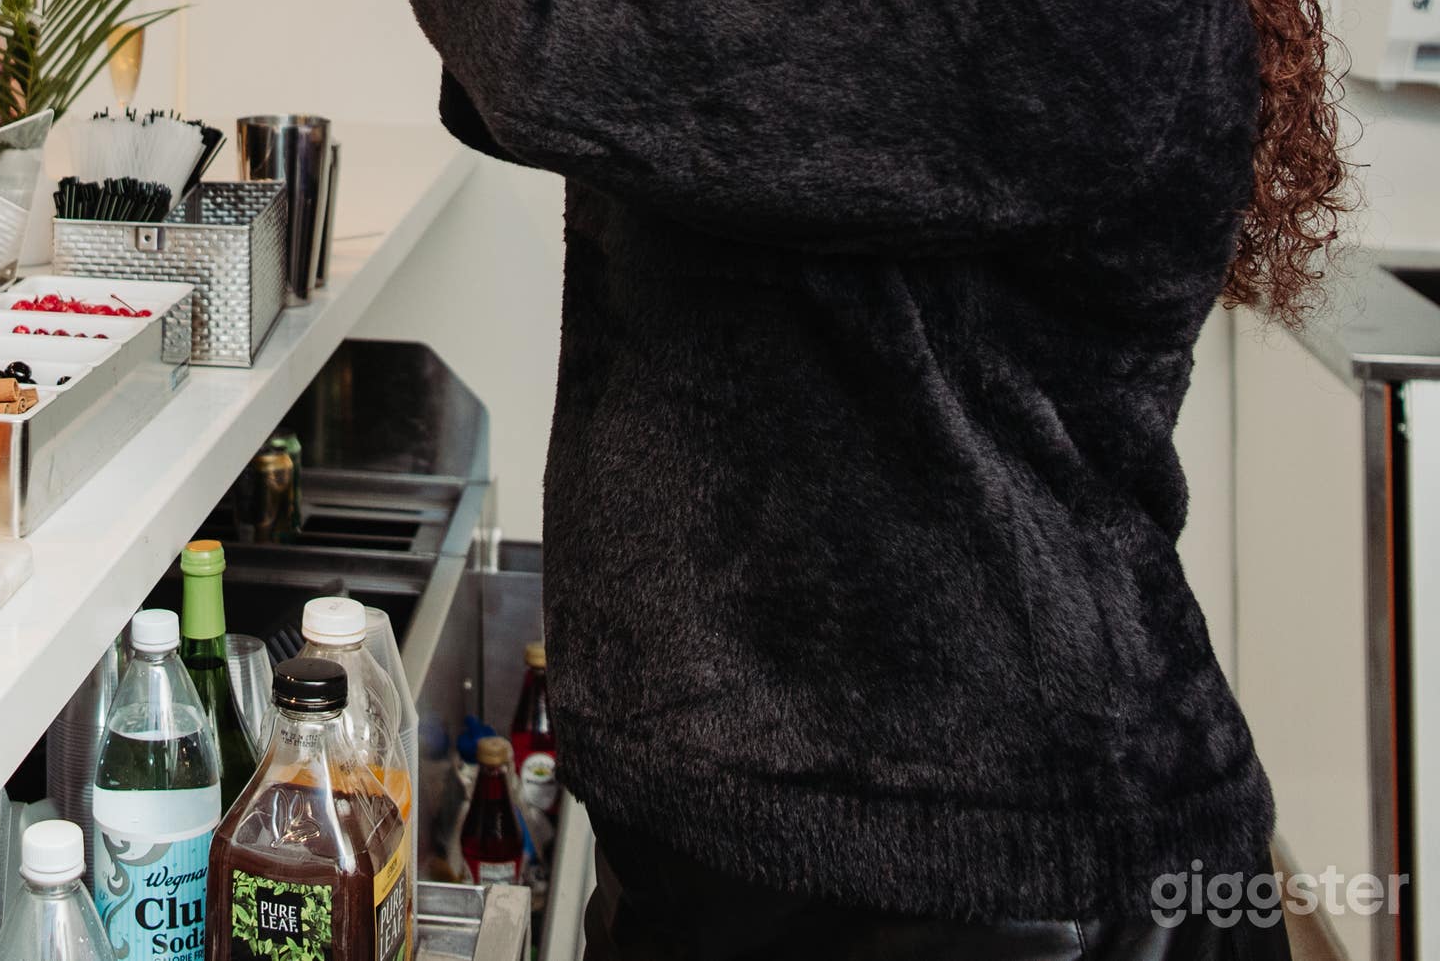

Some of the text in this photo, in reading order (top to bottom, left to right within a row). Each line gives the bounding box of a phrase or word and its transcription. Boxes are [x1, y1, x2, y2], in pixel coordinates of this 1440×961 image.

[135, 889, 206, 931] Clu
[261, 901, 298, 921] PURE
[380, 876, 405, 929] PURE
